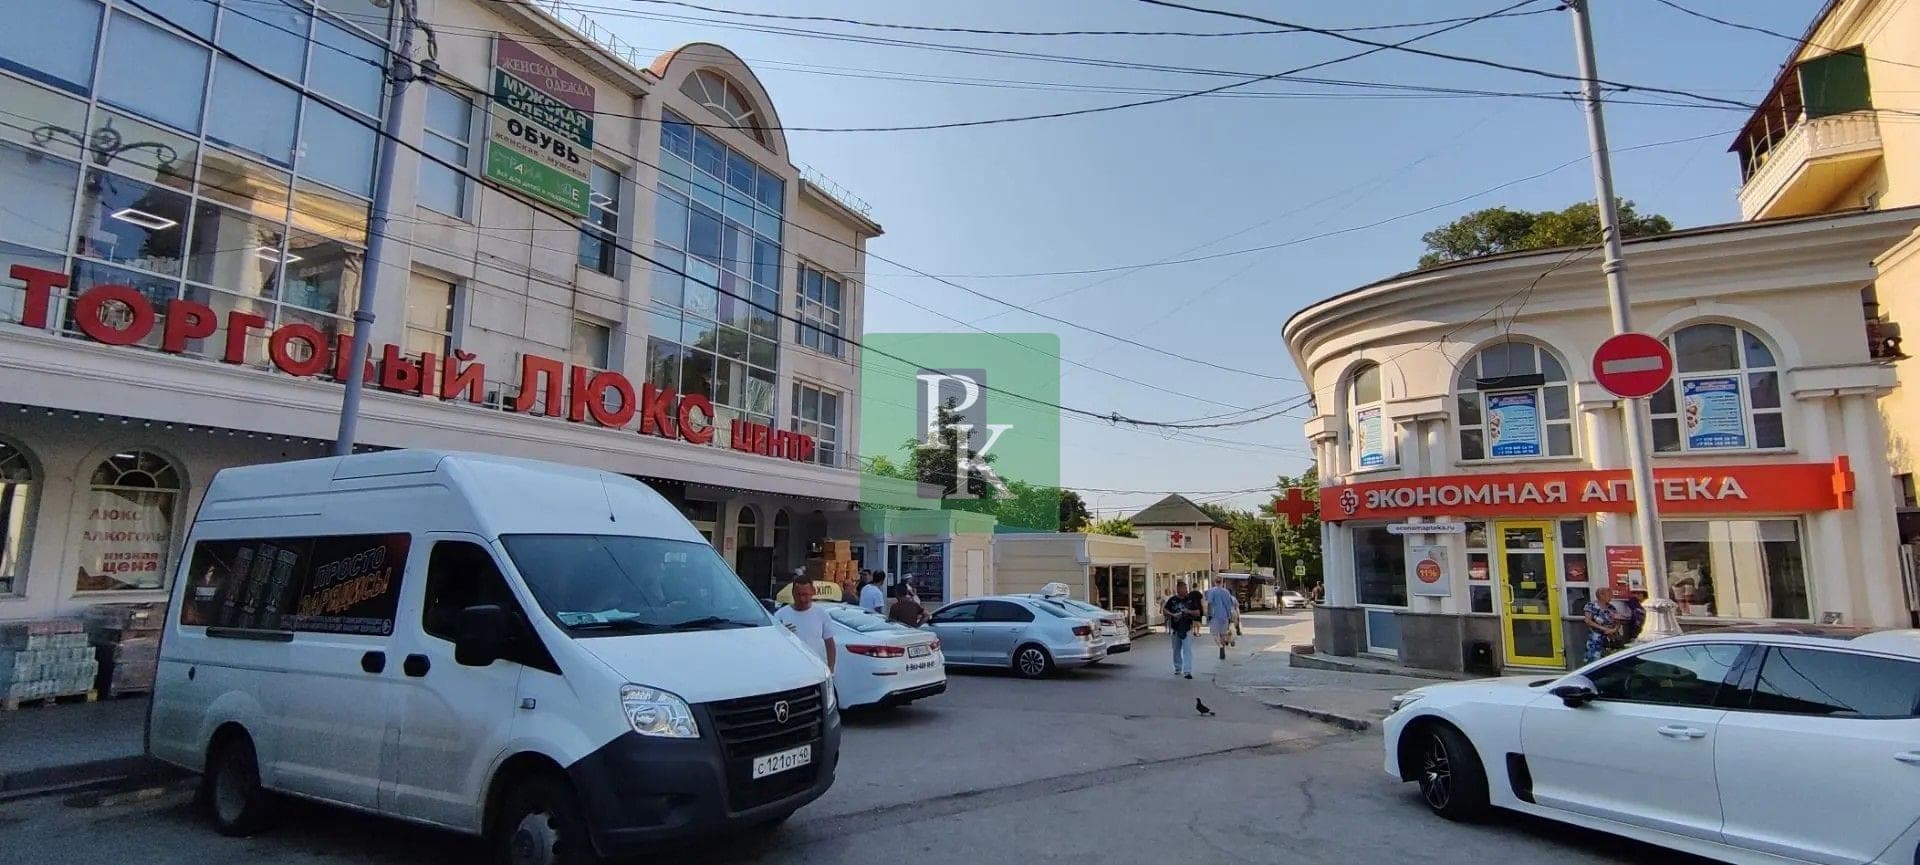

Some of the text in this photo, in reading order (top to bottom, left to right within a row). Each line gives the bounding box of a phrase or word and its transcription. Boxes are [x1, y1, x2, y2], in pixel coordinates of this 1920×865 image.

[501, 59, 558, 78] ЖЕНСКАЯ
[545, 78, 591, 97] ОДЕЖДА
[503, 74, 587, 131] МУЖСКАЯ
[507, 118, 580, 164] ОБУВЬ
[10, 264, 816, 462] ТОРГОВЫЙ ЛЮКС ЦЕНТР
[1364, 476, 1748, 509] ЭКОНОМНАЯ АПЕКА
